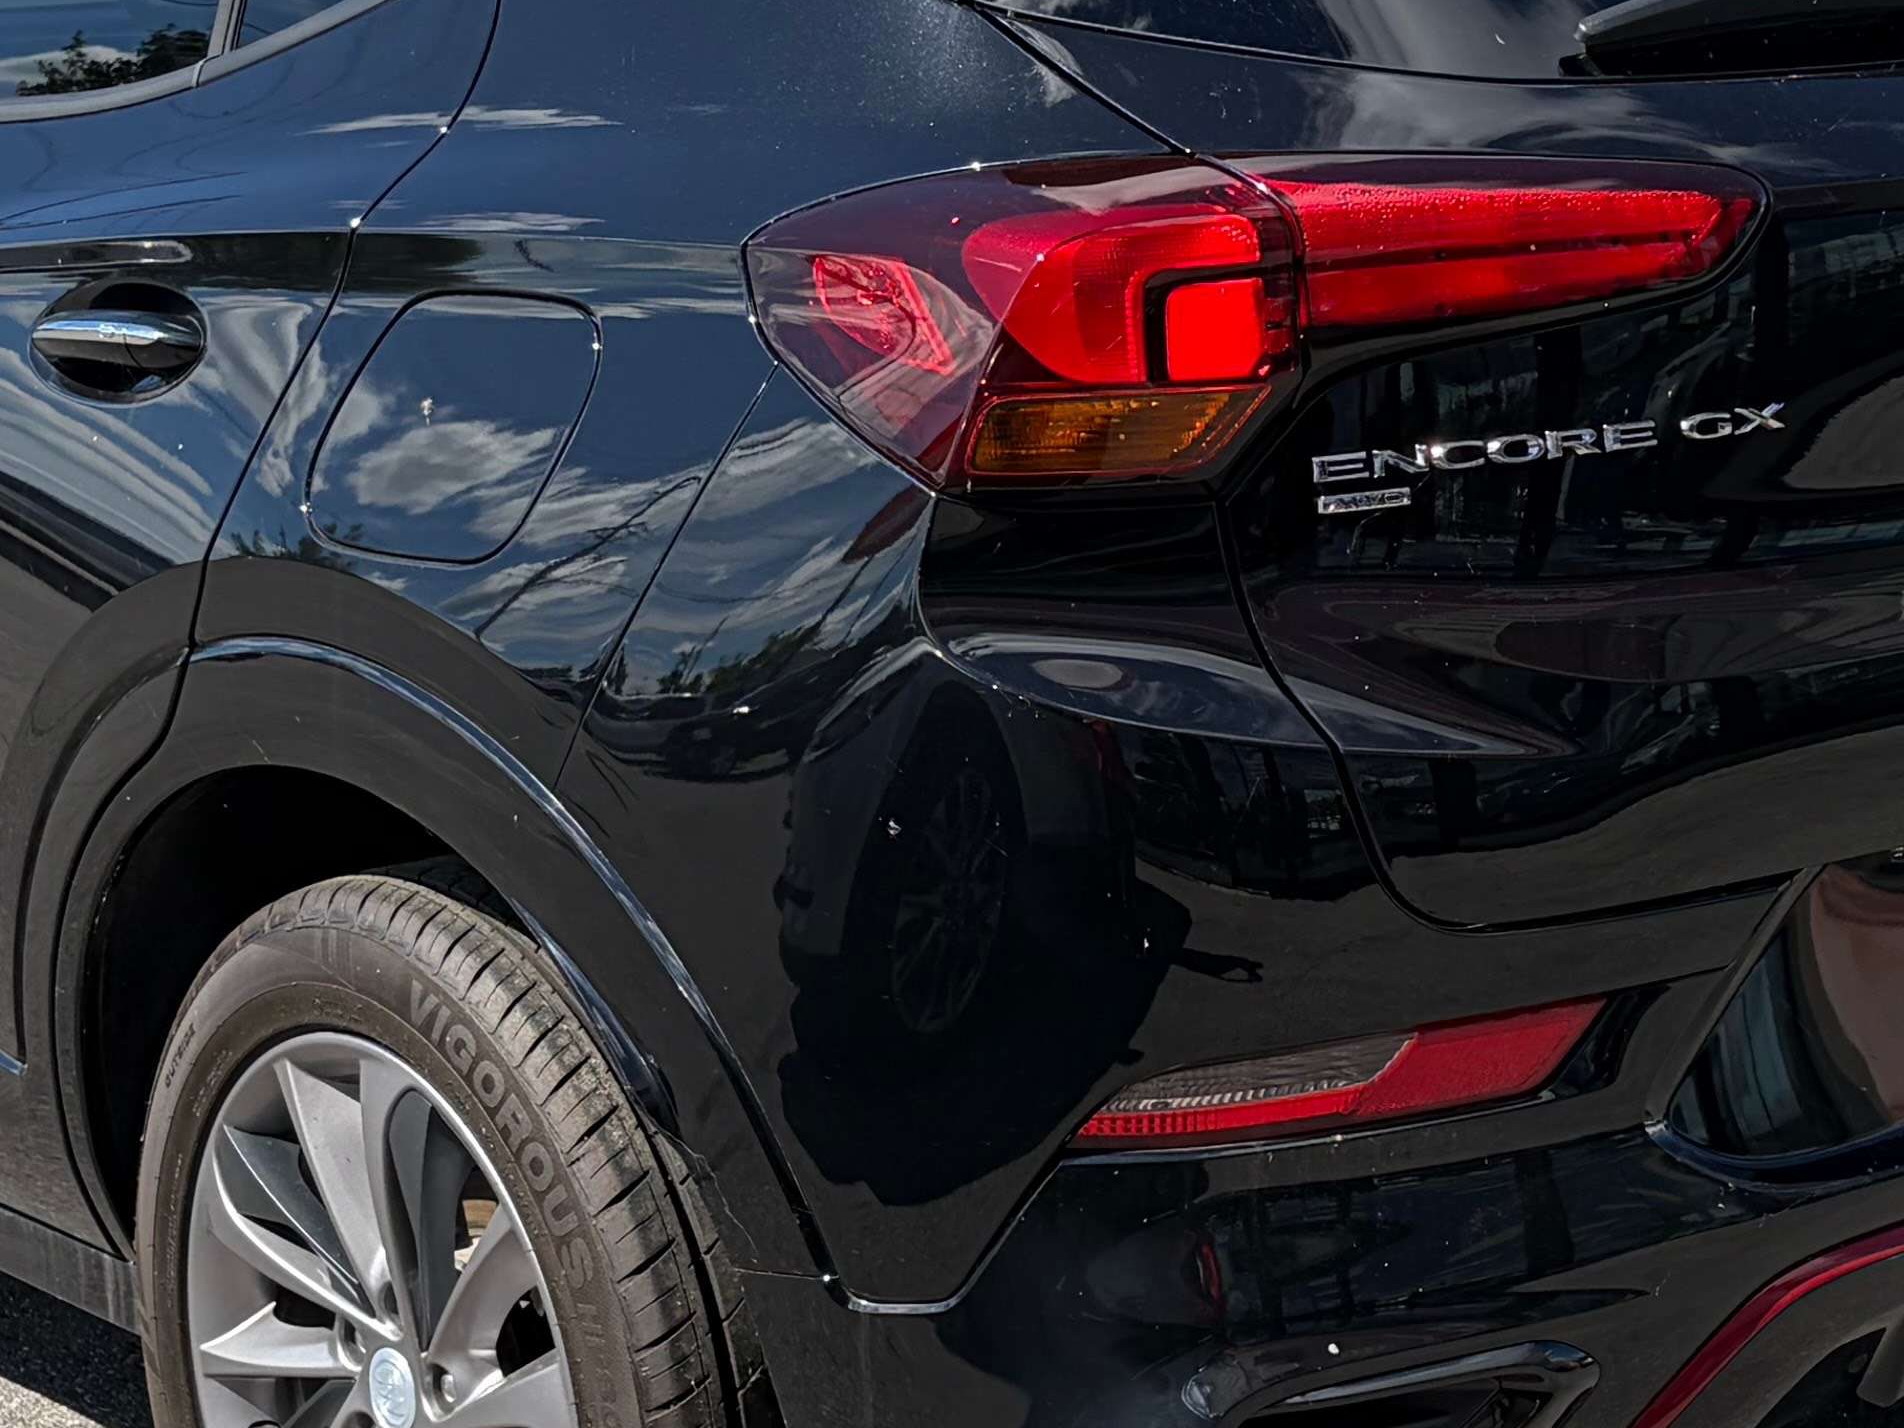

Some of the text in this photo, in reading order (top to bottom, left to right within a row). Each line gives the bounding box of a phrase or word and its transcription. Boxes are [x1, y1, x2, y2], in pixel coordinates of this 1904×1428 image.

[1312, 402, 1785, 483] ENCORE GX
[409, 979, 593, 1290] VIGOROUS
